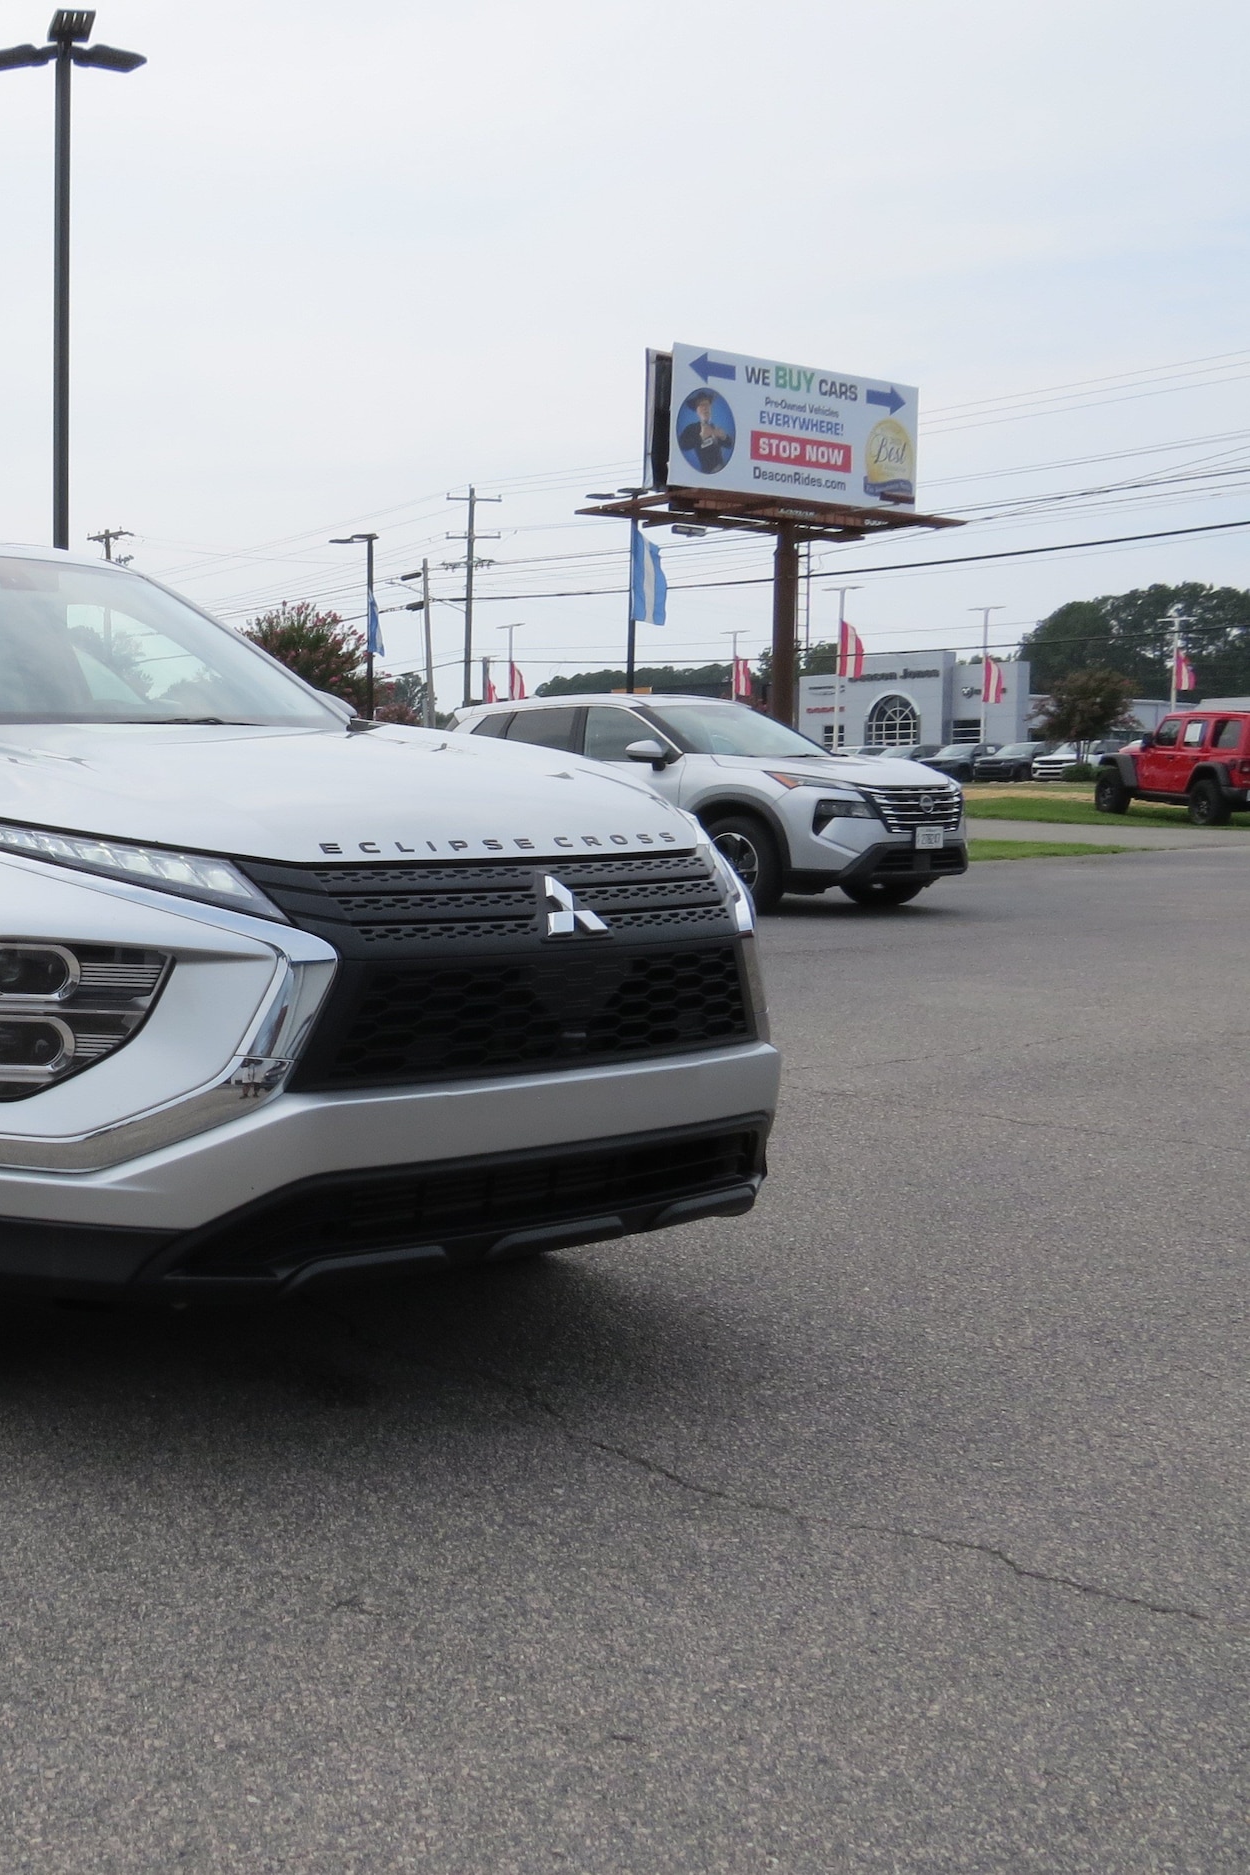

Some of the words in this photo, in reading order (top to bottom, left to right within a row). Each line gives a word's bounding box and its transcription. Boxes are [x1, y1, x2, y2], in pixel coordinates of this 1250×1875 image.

[745, 366, 770, 387] WE
[774, 366, 815, 393] BUY
[819, 379, 858, 402] CARS
[765, 397, 807, 413] Pre-Owned
[808, 404, 839, 418] Vehicles
[759, 410, 844, 436] EVERYWHERE!
[759, 437, 801, 459] STOP
[806, 445, 844, 466] NOW
[869, 434, 907, 465] Best
[753, 466, 847, 491] DeaconRides.com
[319, 838, 536, 855] ECLIPSE
[553, 832, 676, 848] CROSS
